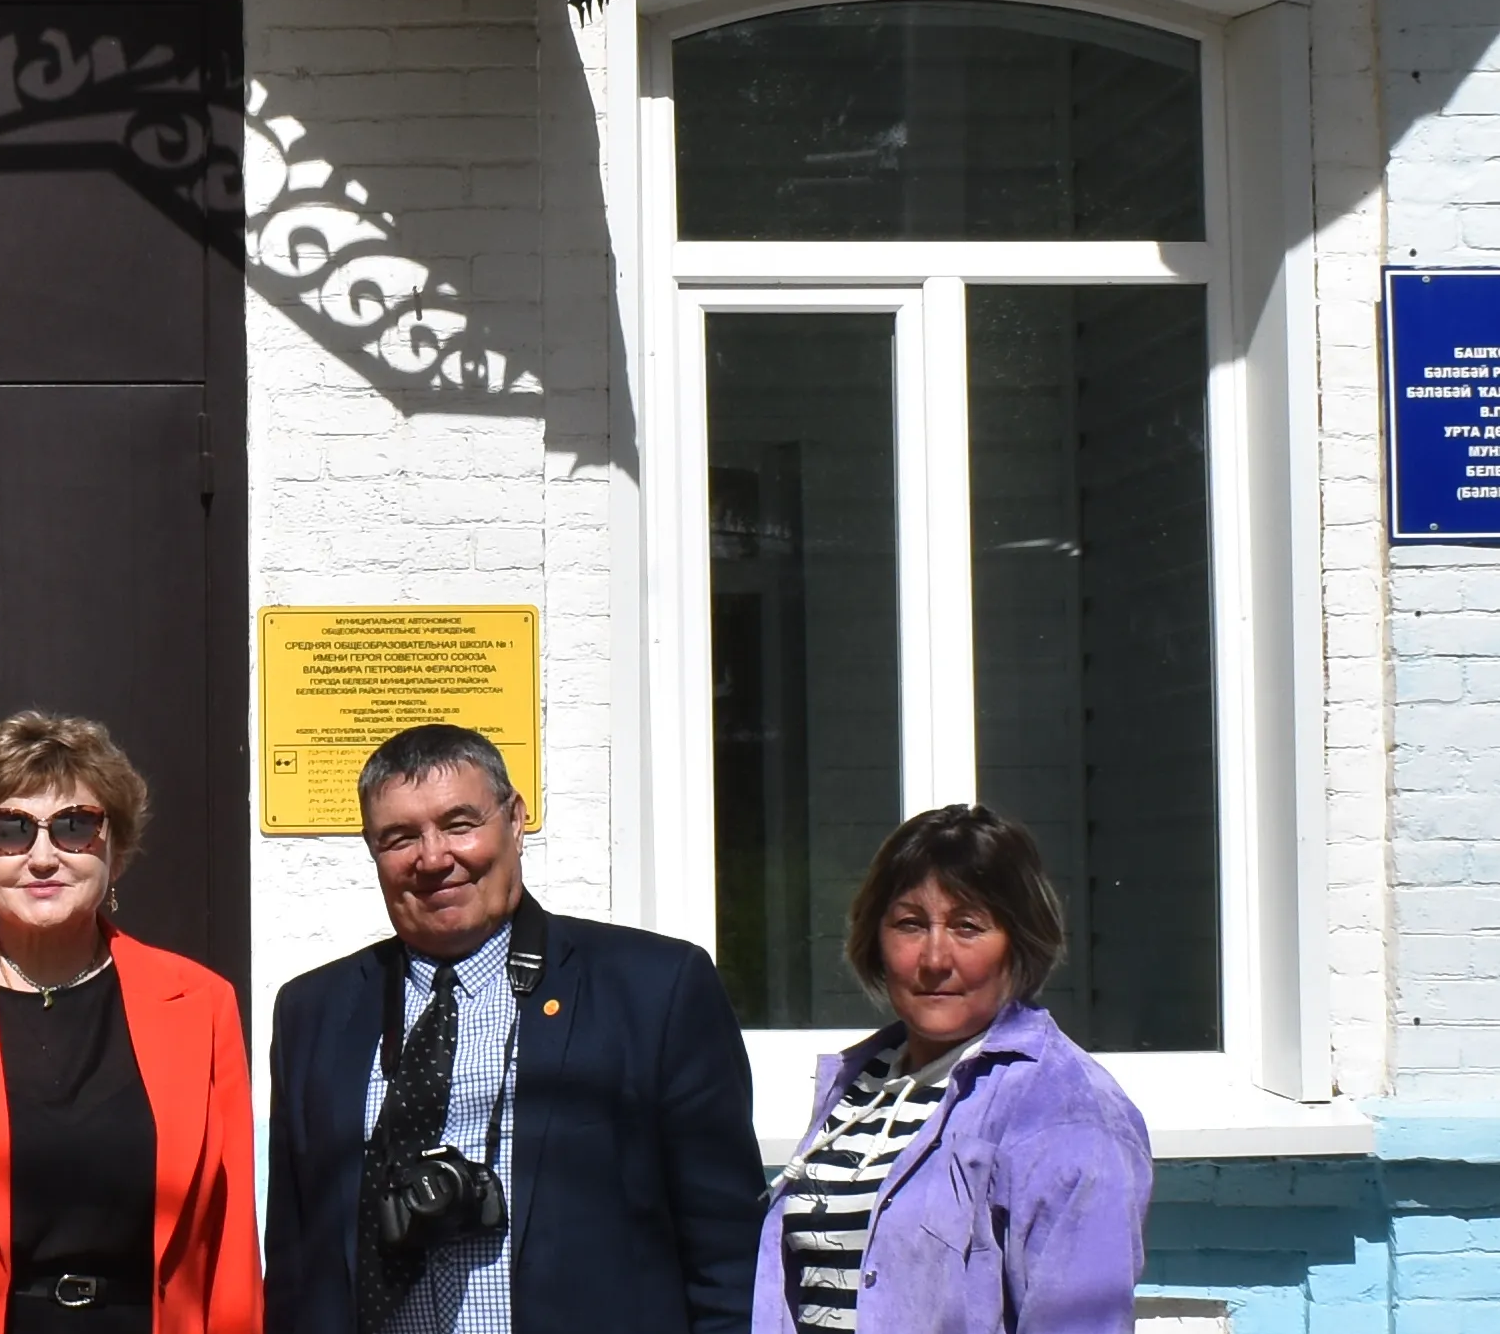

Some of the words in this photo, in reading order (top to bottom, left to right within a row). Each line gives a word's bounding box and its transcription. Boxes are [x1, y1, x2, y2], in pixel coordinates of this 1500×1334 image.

[1444, 425, 1480, 438] УРТА
[285, 641, 331, 651] СРЕДНЯЯ
[334, 641, 457, 651] ОБЩЕОБРАЗОВАТЕЛЬНАЯ
[459, 641, 492, 650] ШКОЛА
[313, 653, 348, 662] ИМЕНИ
[350, 653, 382, 662] ГЕРОЯ
[384, 653, 448, 662] СОВЕТСКОГО
[451, 653, 486, 661] СОЮЗА
[303, 665, 362, 675] ВЛАДИМИРА
[364, 665, 422, 674] ПЕТРОВИЧА
[425, 665, 496, 674] ФЕРАПОНТОВА
